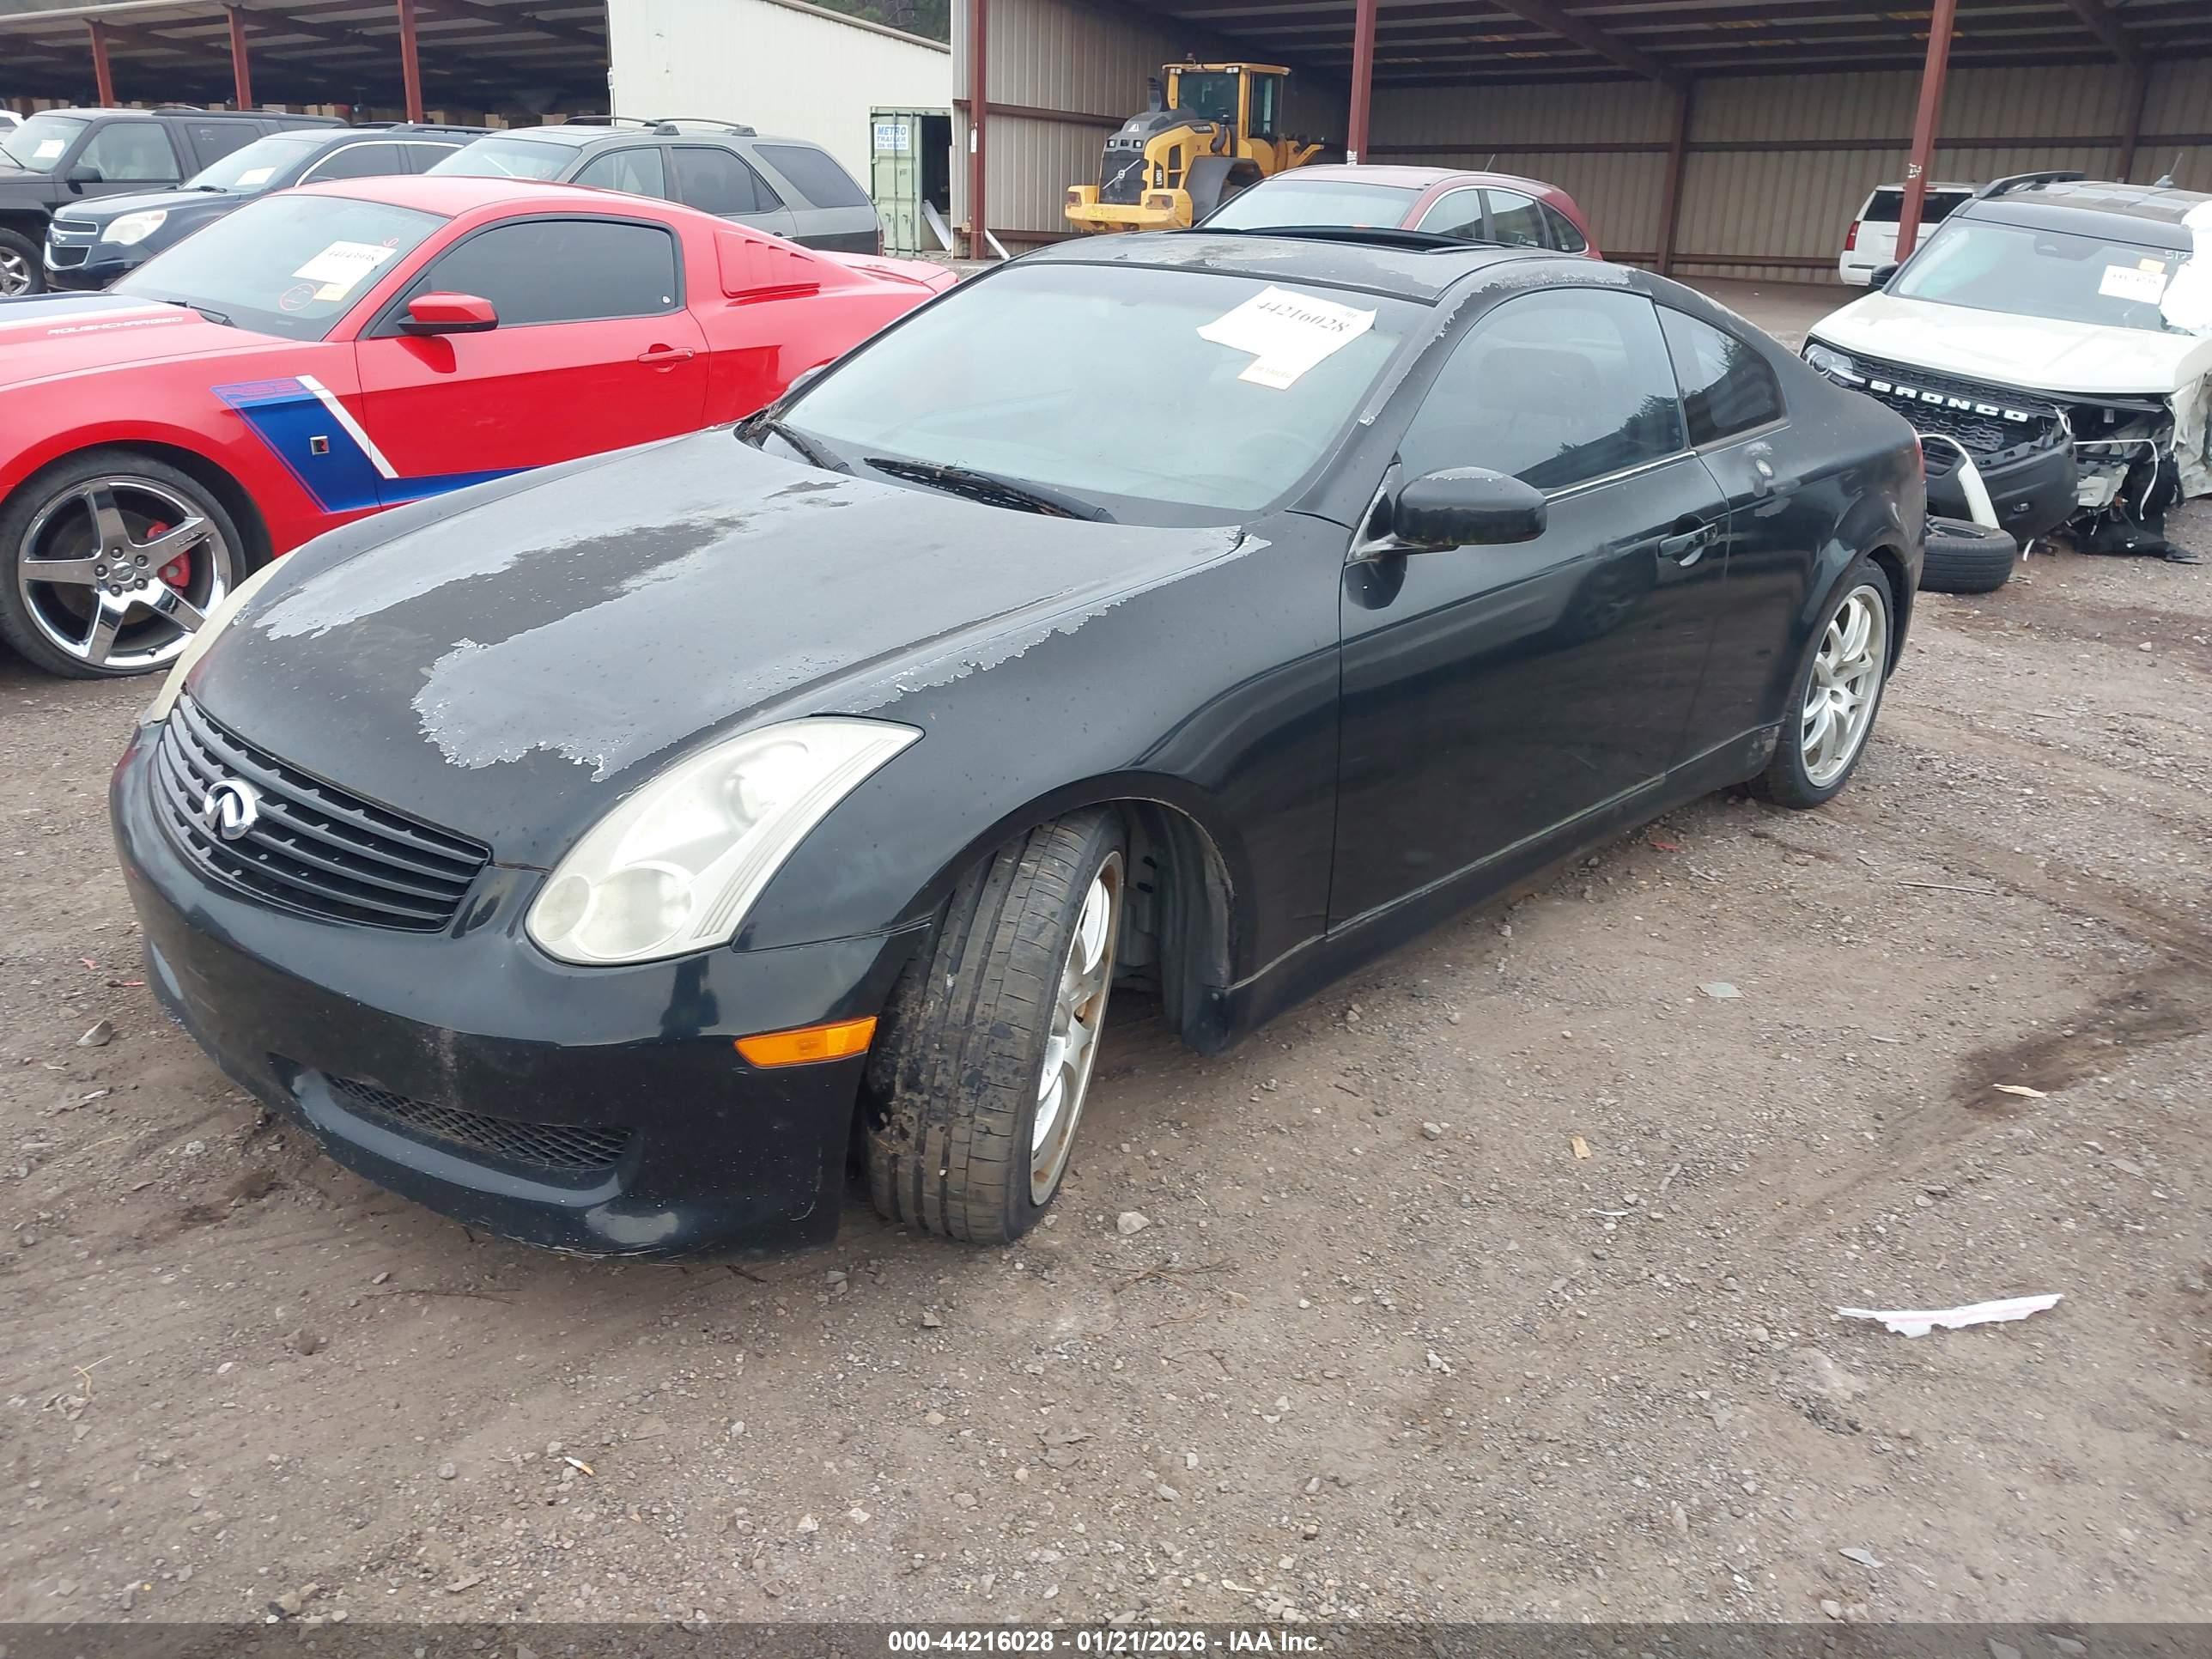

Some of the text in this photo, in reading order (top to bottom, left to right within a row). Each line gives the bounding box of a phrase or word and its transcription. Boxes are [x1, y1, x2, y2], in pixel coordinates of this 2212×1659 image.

[878, 126, 907, 136] METRO
[1256, 301, 1351, 332] 44216028
[1870, 380, 2028, 422] BRONCO
